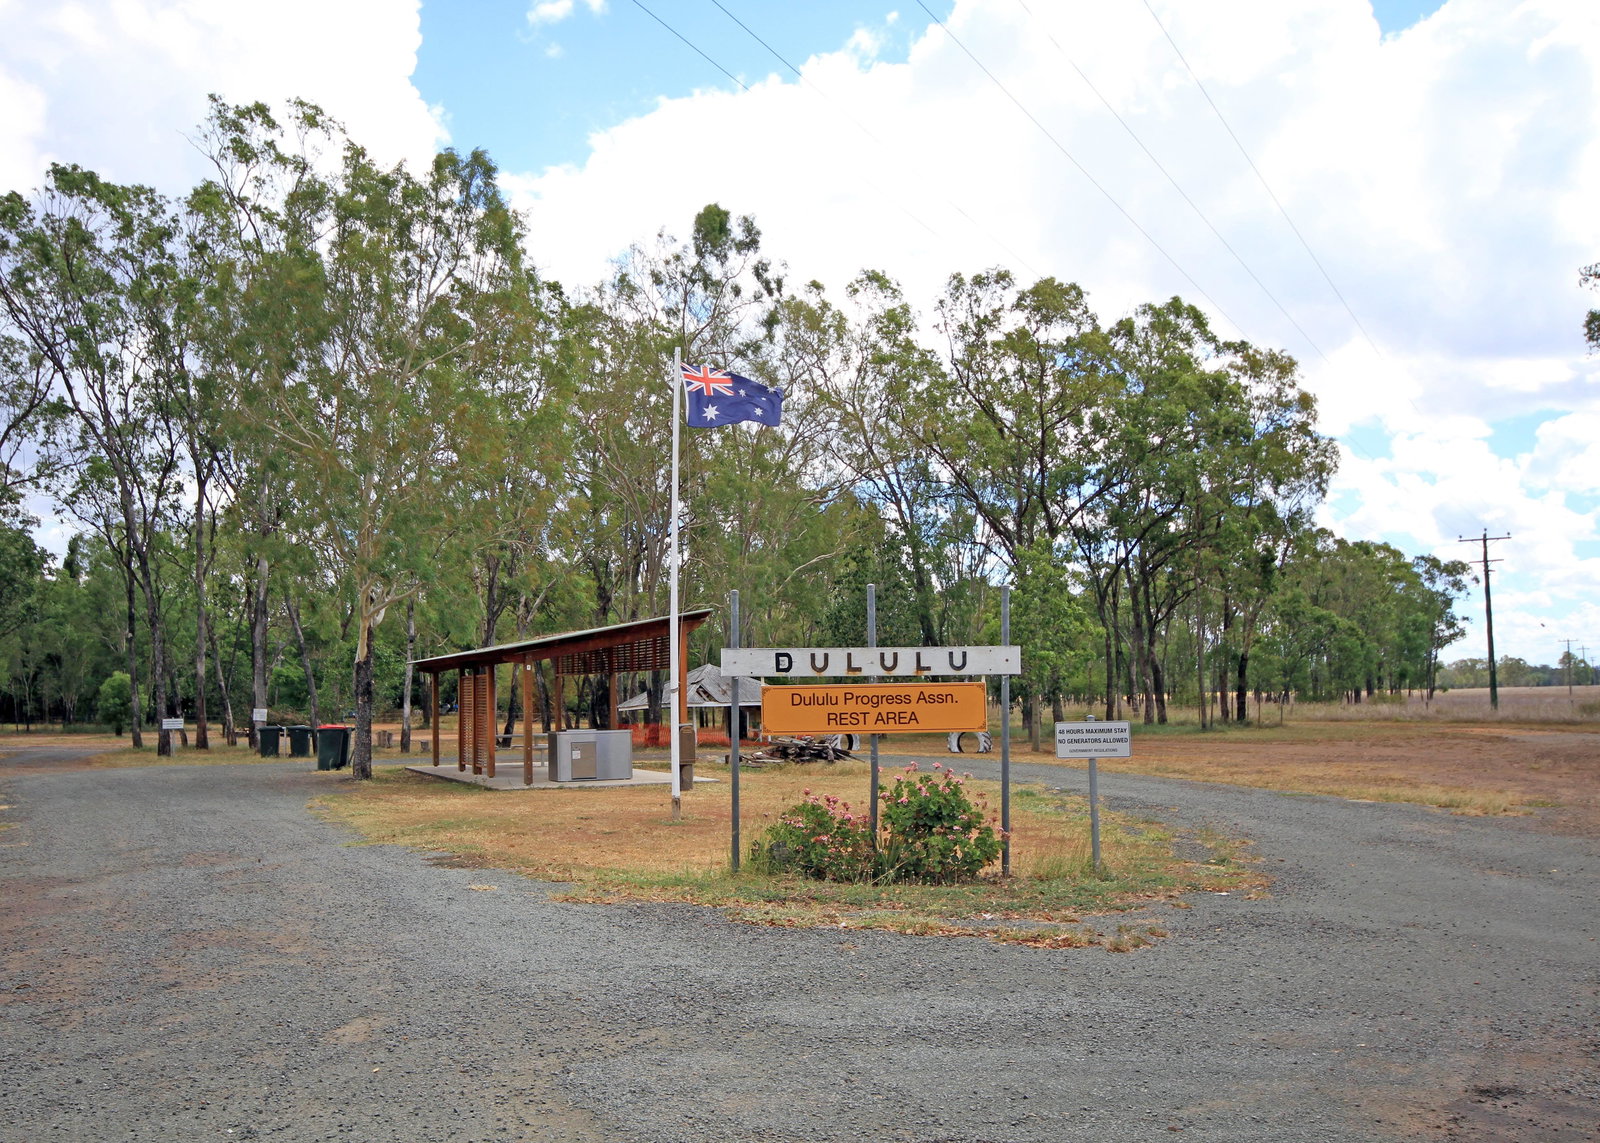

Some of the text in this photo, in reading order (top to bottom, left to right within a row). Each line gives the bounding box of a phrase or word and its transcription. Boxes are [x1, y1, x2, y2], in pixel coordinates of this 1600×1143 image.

[775, 651, 967, 673] DULULU
[791, 691, 959, 708] Dululu Progress Assn.
[827, 712, 919, 726] REST AREA
